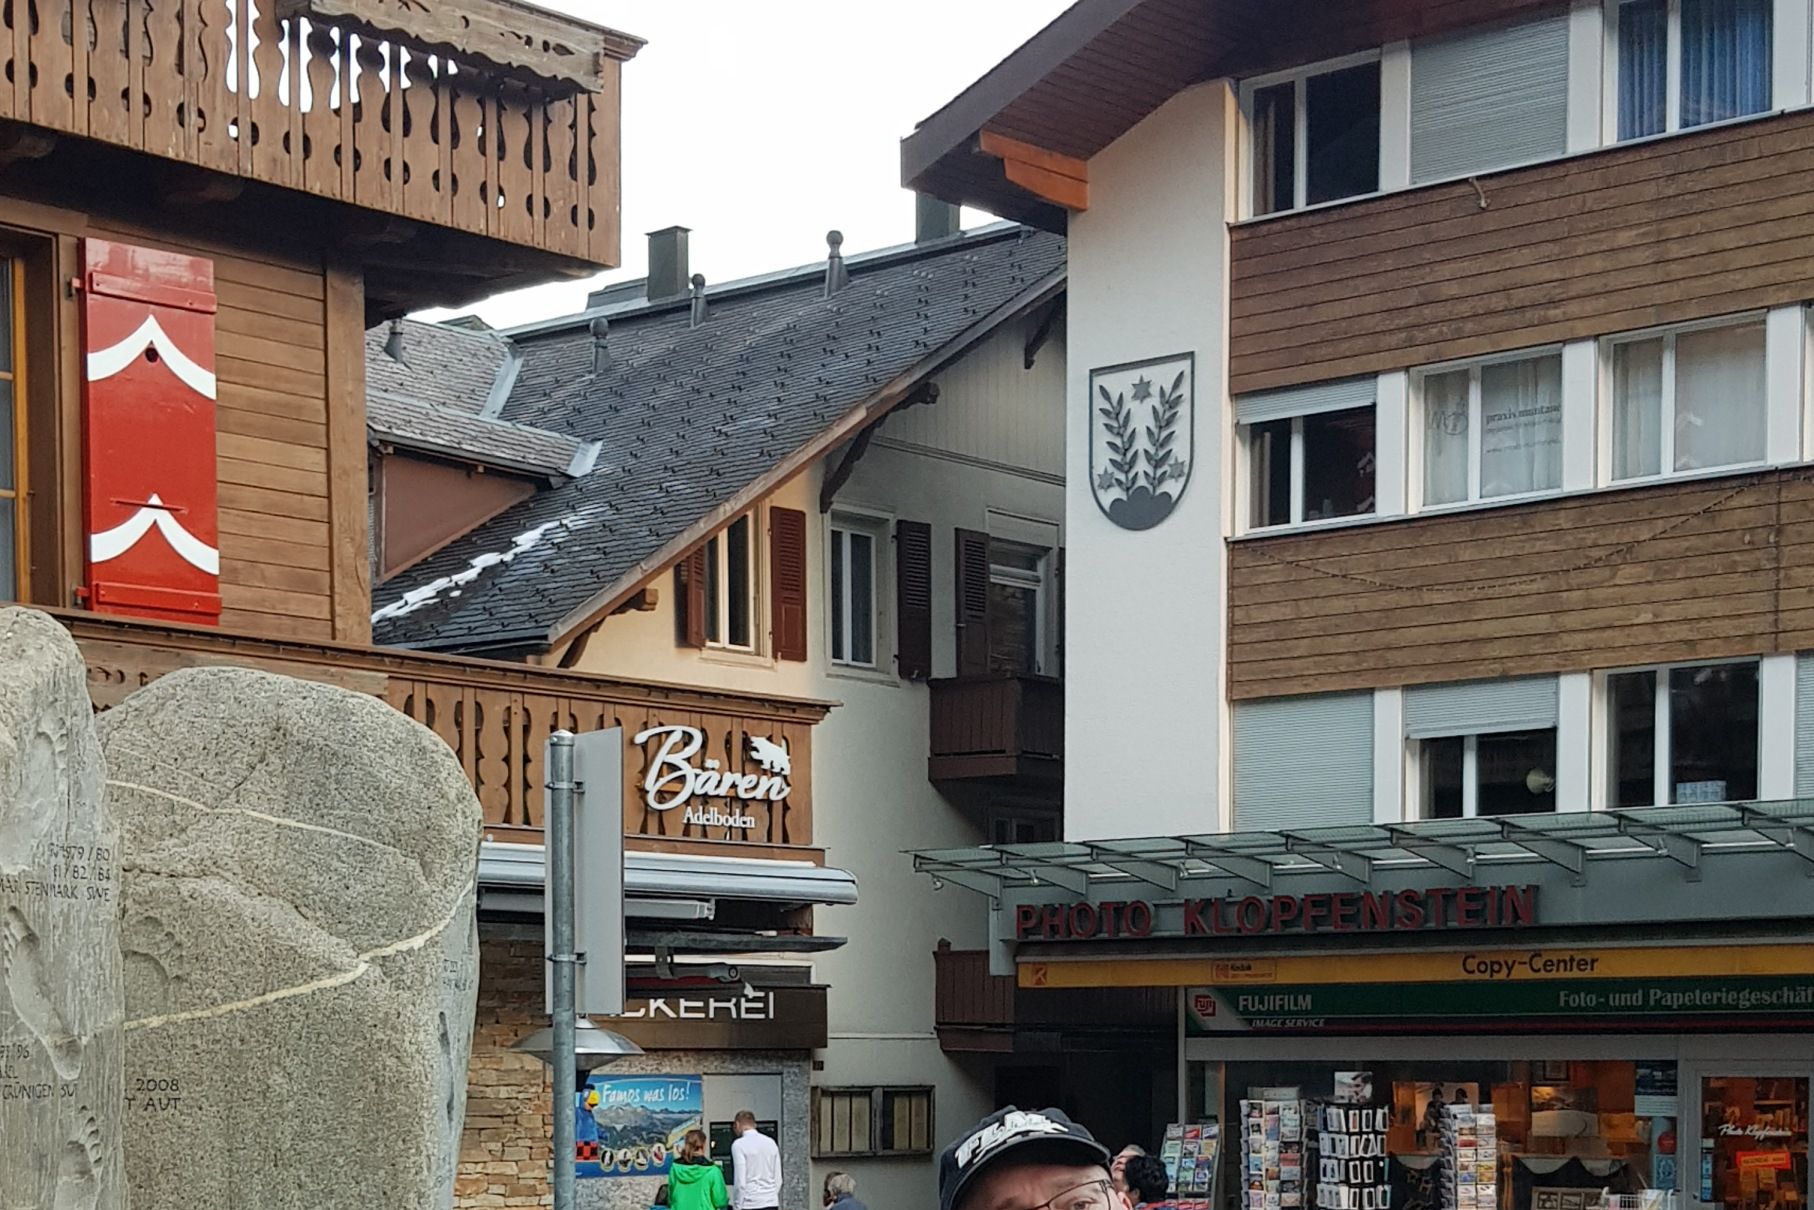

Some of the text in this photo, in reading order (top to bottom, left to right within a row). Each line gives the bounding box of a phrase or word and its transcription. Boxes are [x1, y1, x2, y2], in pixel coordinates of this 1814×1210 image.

[634, 725, 791, 811] Bären
[683, 806, 755, 828] Adelboden
[1016, 884, 1540, 939] PHOTO KLOPFENSTEIN
[1462, 952, 1599, 978] Copy-Center
[1239, 995, 1312, 1011] FUJIFILM
[1252, 1018, 1325, 1027] IMAGE SERVICE
[136, 1078, 179, 1092] 2008
[602, 1084, 640, 1103] Famos
[143, 1097, 181, 1112] AUT
